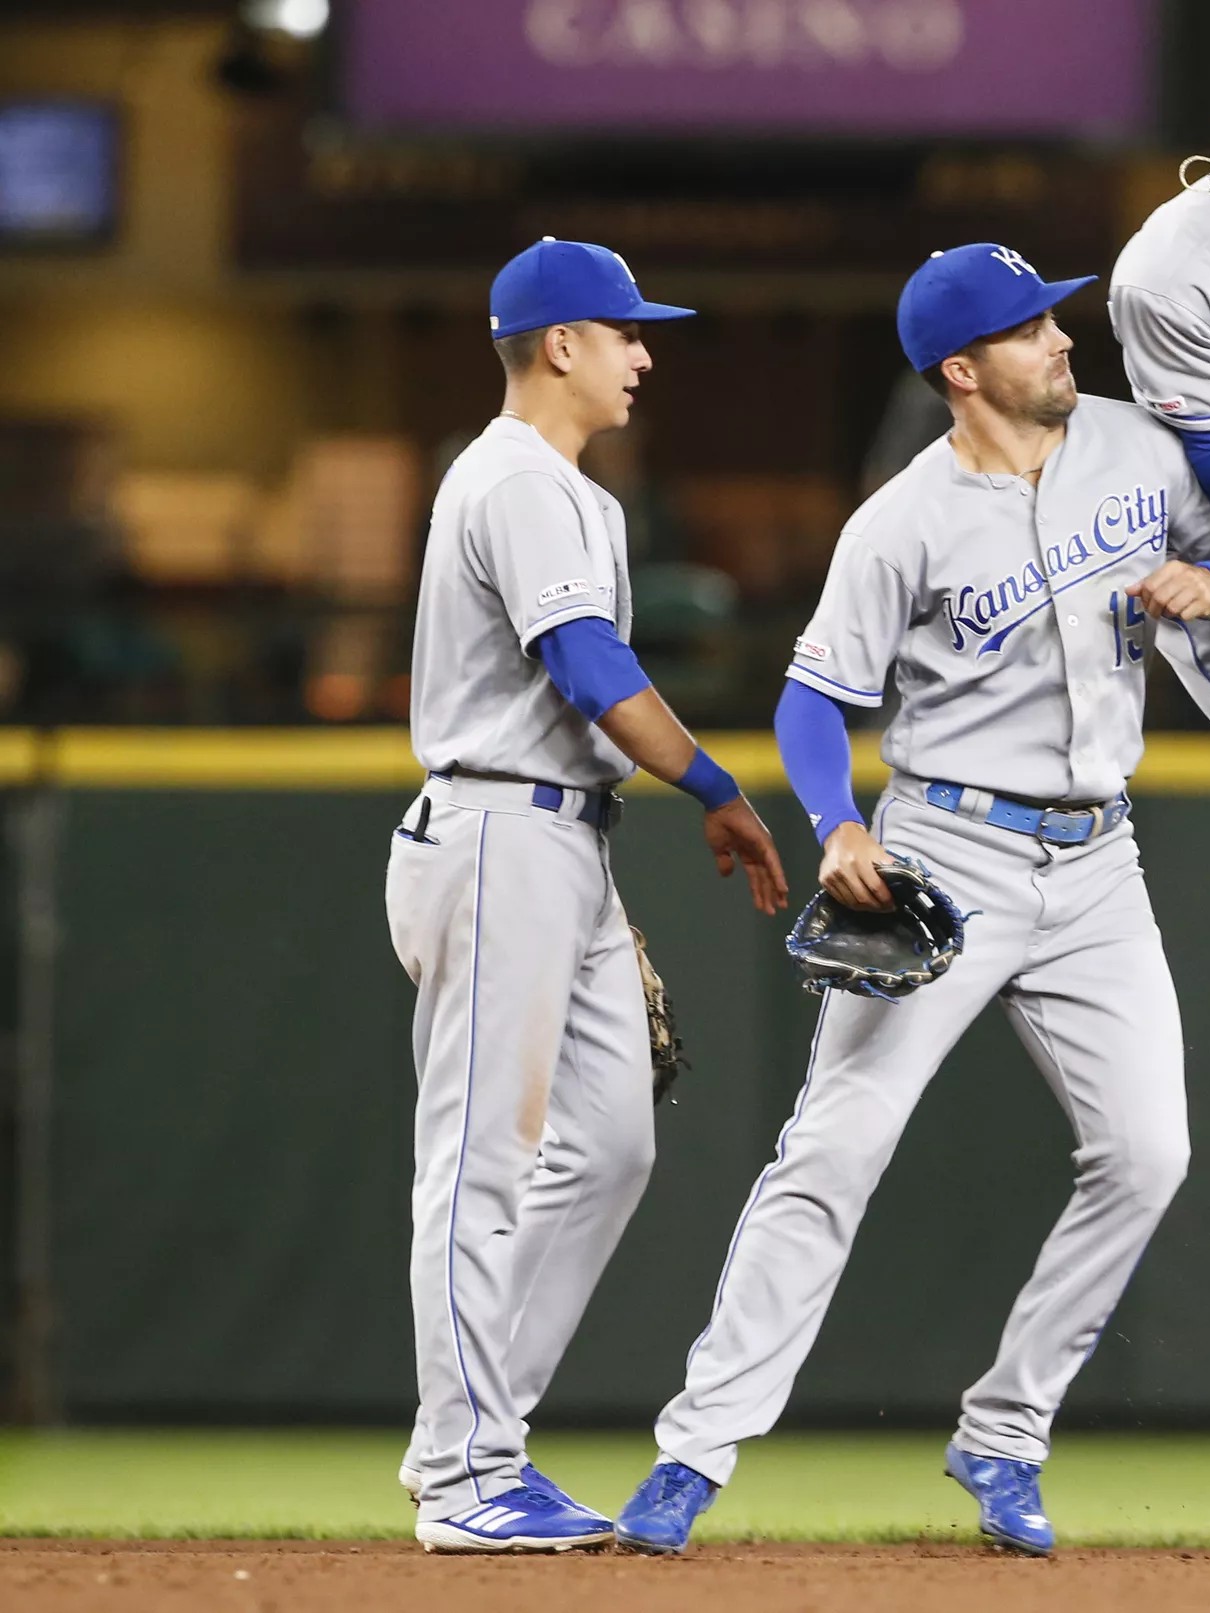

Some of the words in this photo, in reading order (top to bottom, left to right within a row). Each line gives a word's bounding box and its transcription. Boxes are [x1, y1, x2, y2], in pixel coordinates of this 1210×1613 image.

[942, 532, 1094, 652] Kansas
[1093, 485, 1168, 554] City
[1109, 590, 1145, 669] 15
